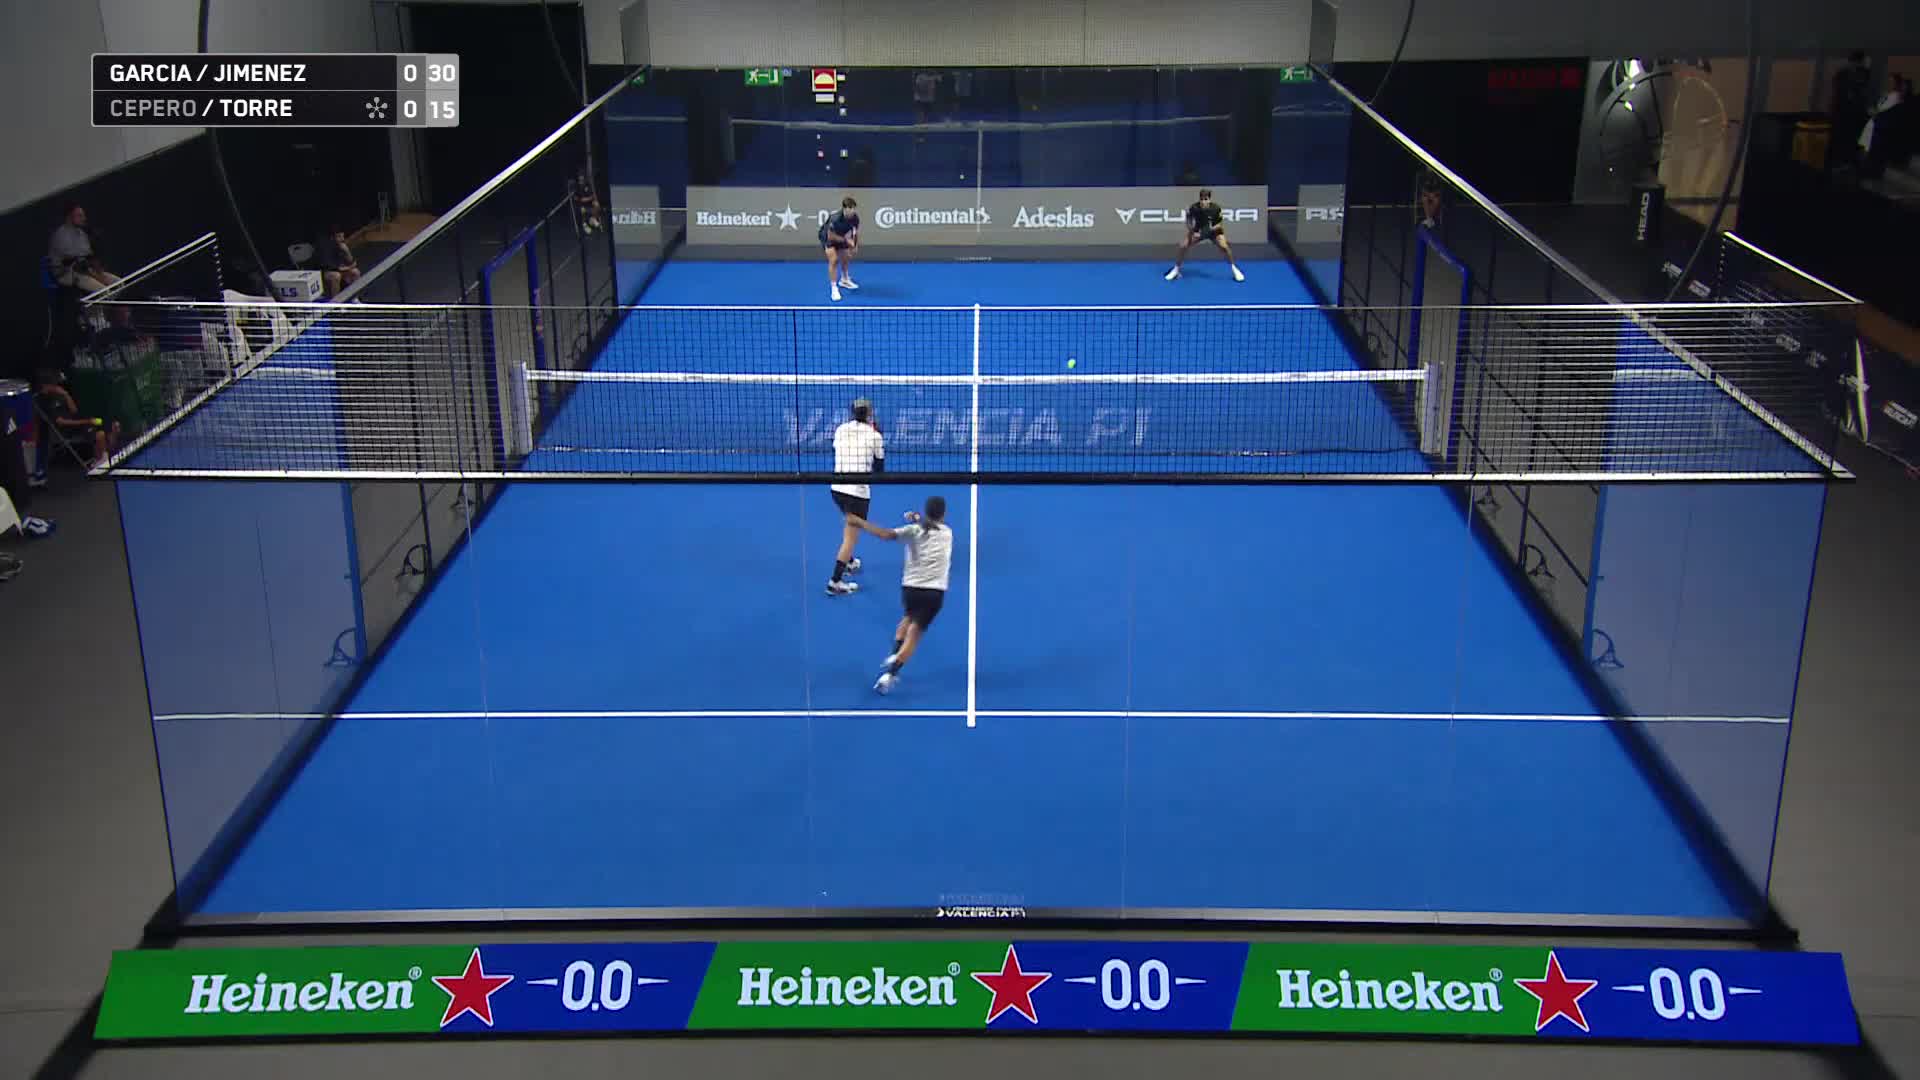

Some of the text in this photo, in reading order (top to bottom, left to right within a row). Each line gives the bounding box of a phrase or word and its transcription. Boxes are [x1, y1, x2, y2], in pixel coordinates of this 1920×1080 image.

[696, 210, 772, 227] Heineken
[874, 206, 976, 229] Continental
[1012, 205, 1096, 228] Adeslas
[1140, 208, 1259, 223] CURA
[1636, 192, 1650, 241] HEAD
[184, 960, 633, 1014] Heineken 0.0
[736, 958, 1171, 1011] Heineken 0.0
[1276, 968, 1727, 1022] Heineken 0.0
